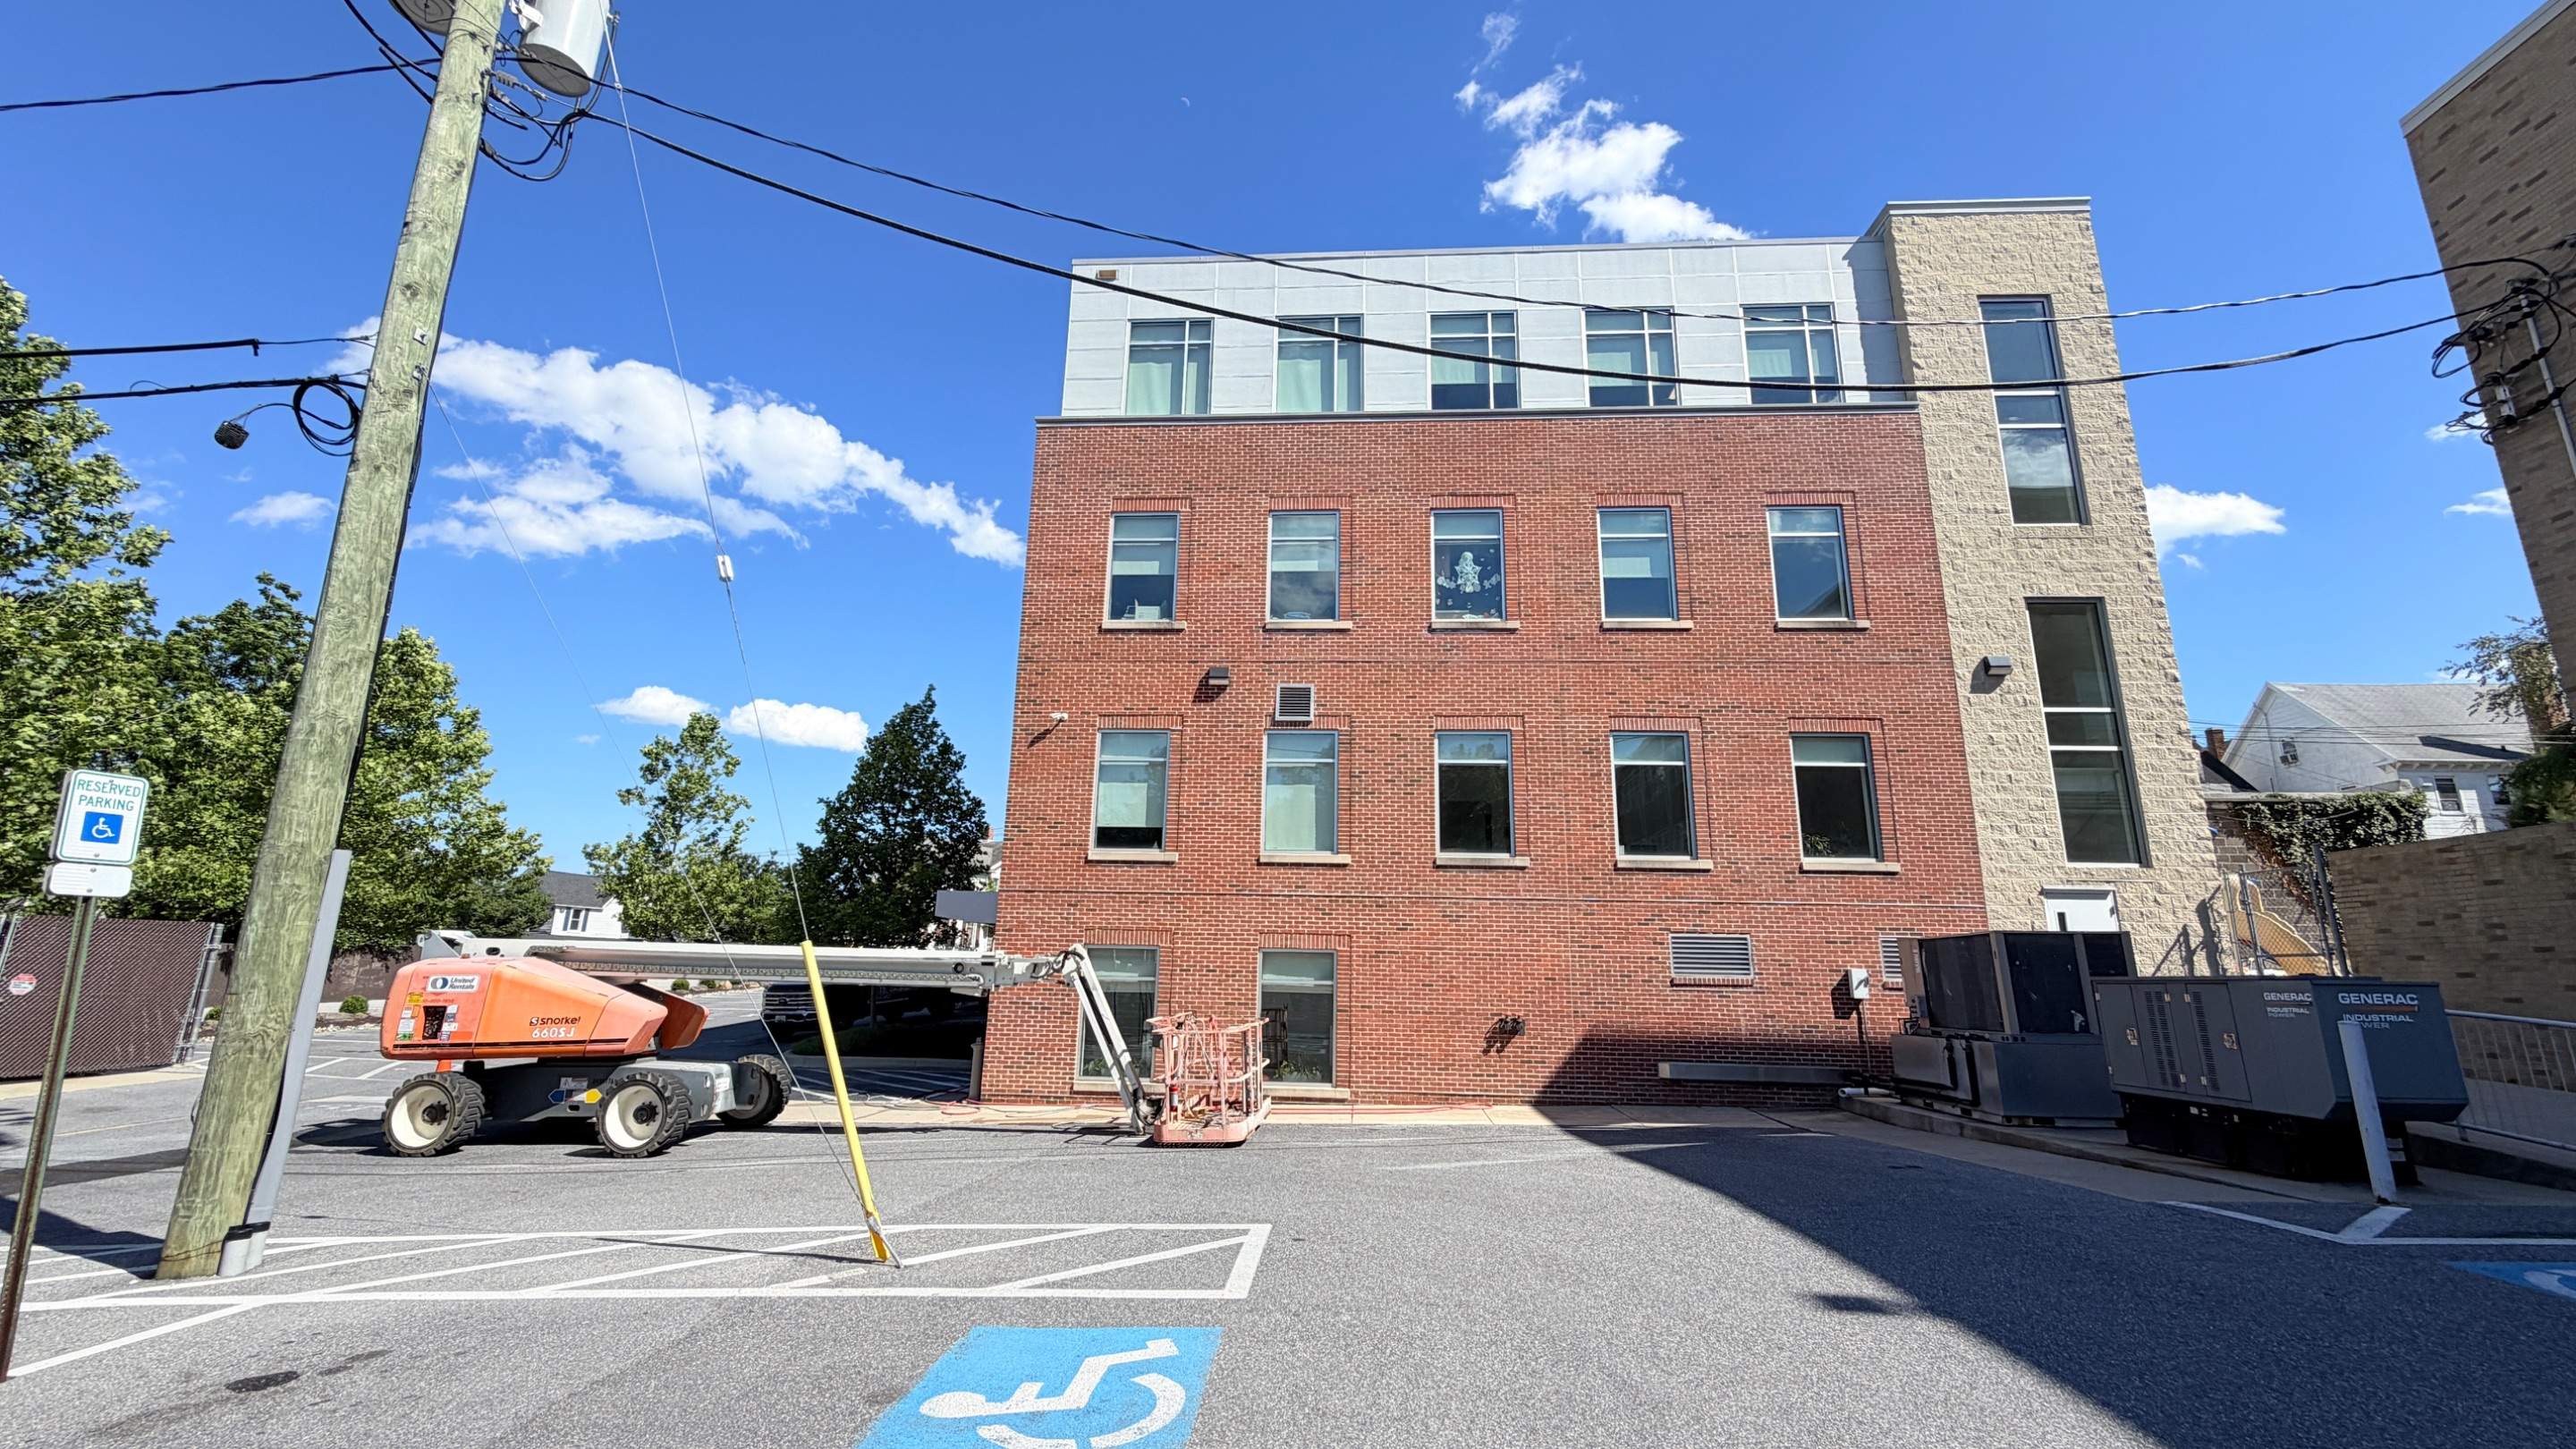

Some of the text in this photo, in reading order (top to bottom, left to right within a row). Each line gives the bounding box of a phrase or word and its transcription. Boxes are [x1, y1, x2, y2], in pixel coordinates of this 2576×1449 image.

[77, 779, 140, 798] RESERVED
[78, 794, 135, 812] PARKING
[2263, 992, 2312, 1002] GENERAC
[2338, 993, 2419, 1005] GENERAC
[539, 1015, 581, 1026] snorkel
[2343, 1013, 2415, 1022] INDUSTRIAL
